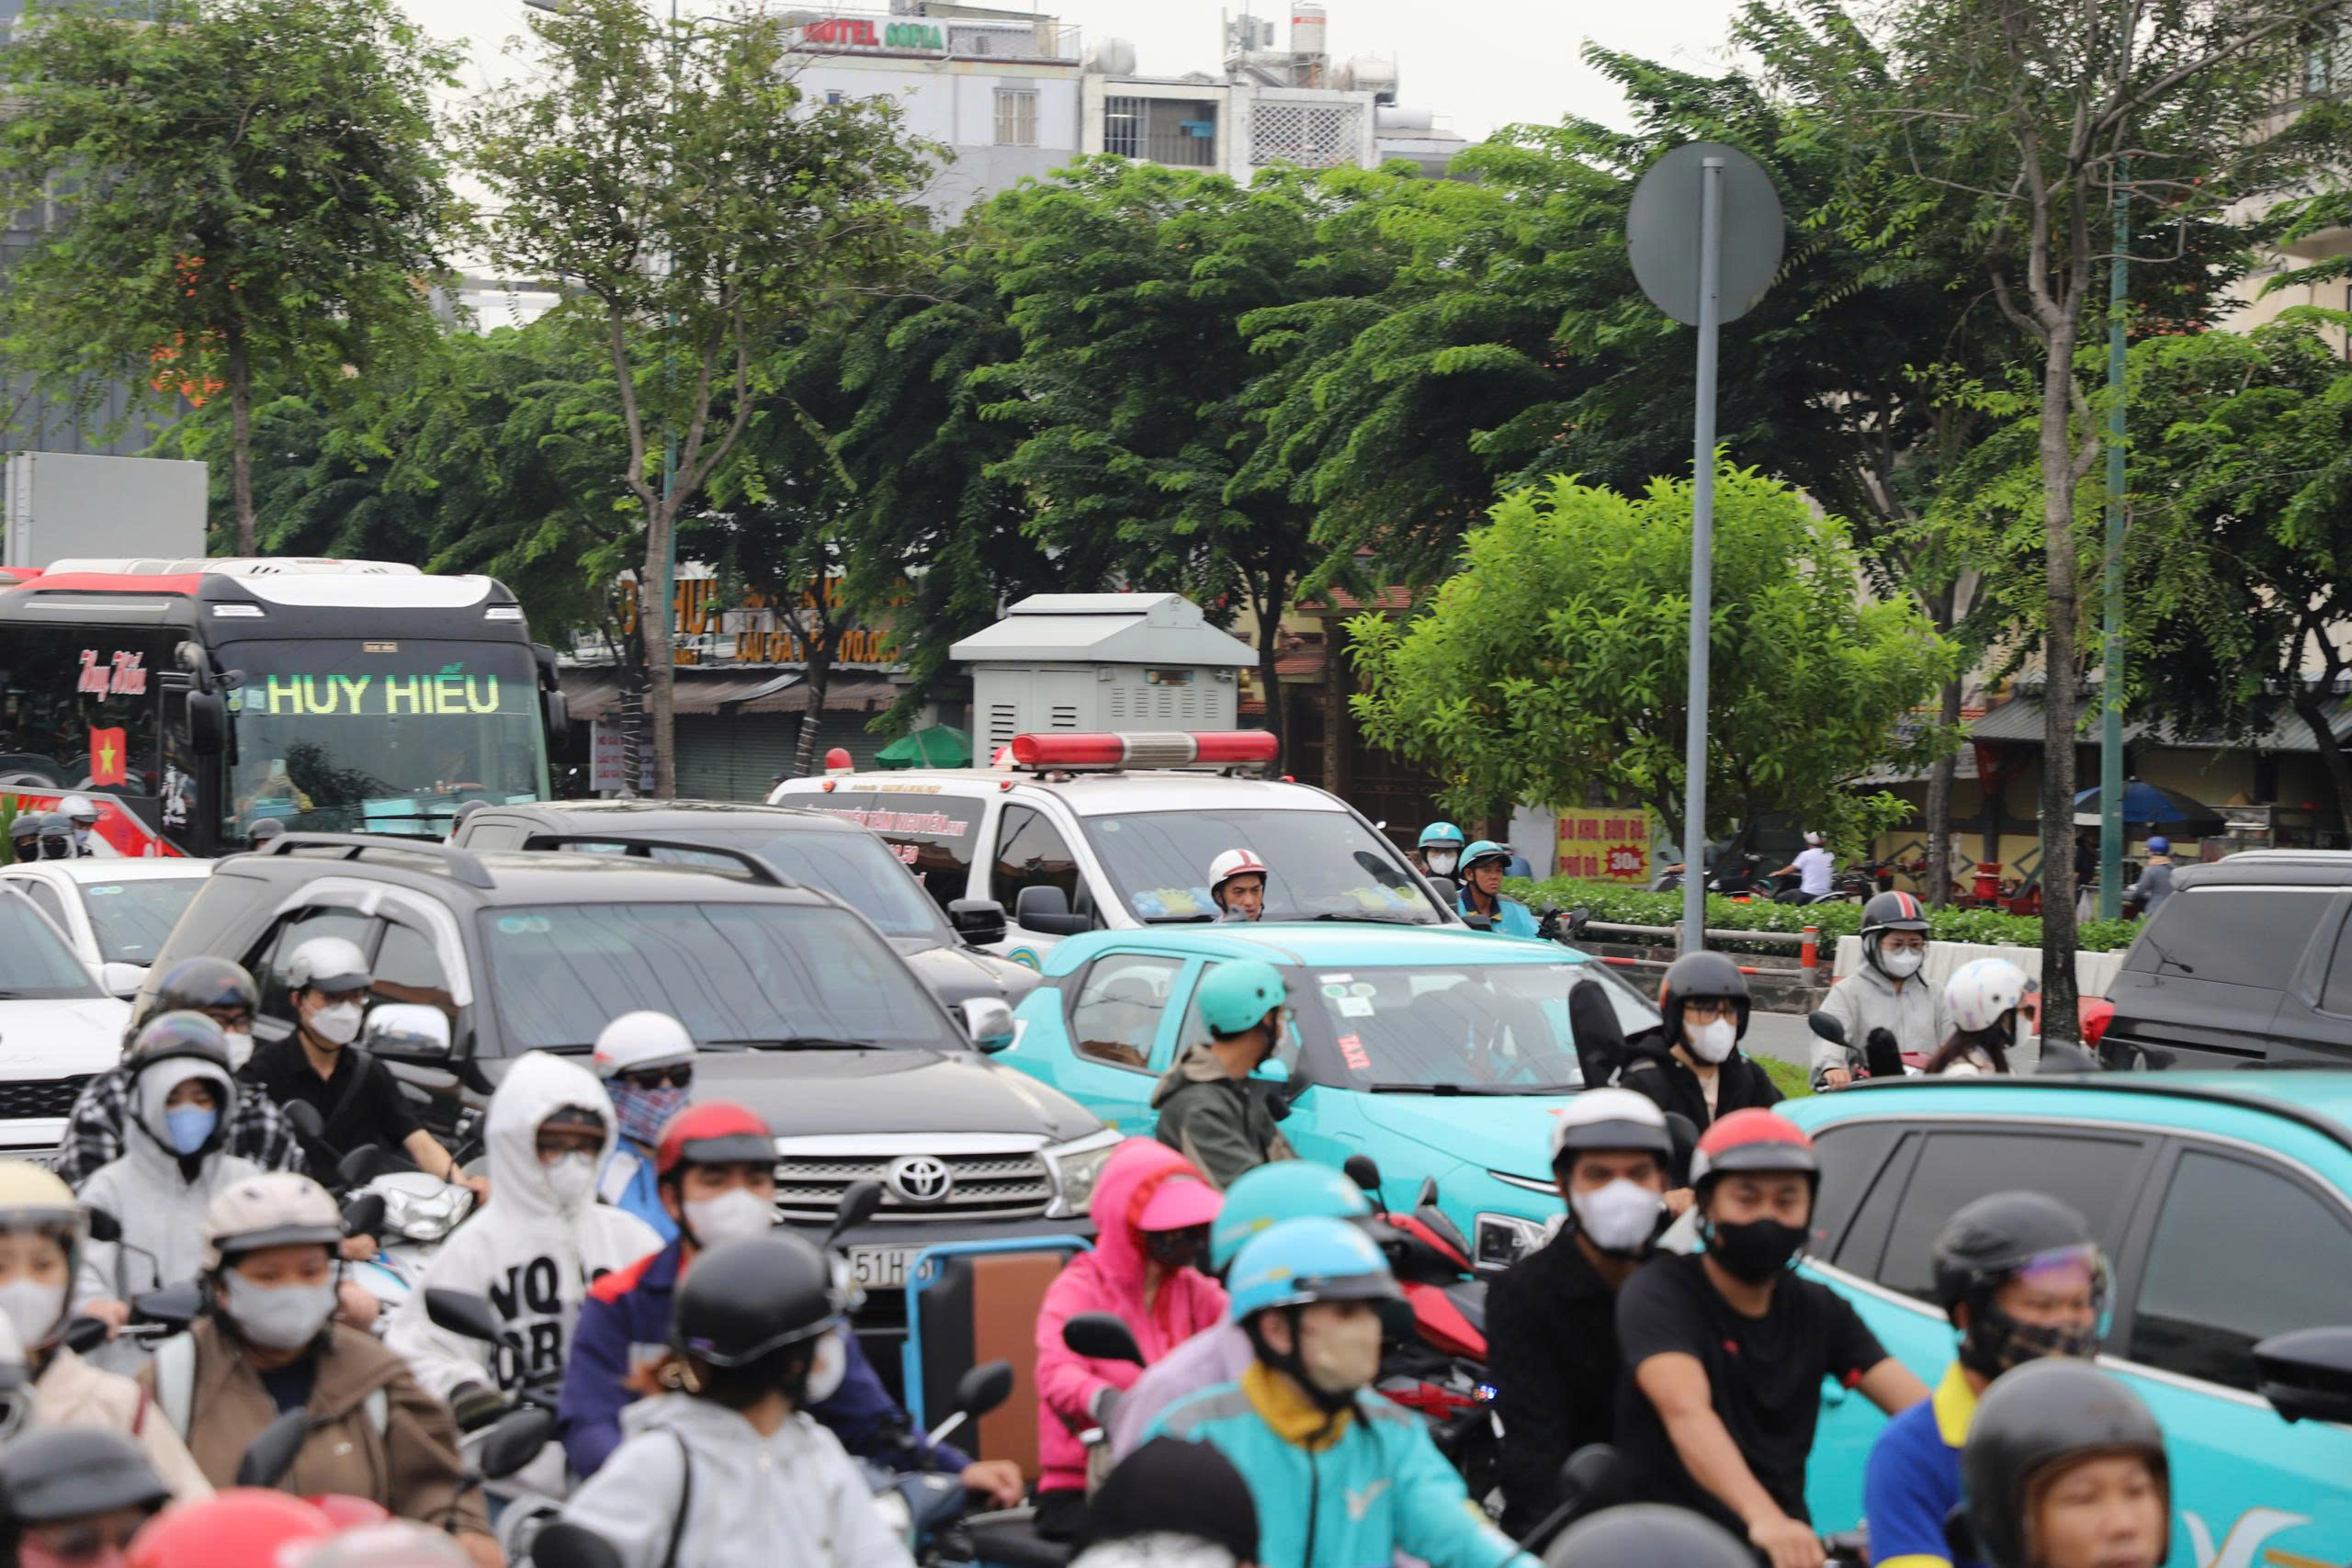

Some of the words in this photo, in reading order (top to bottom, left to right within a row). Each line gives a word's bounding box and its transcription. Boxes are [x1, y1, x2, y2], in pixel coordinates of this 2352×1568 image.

[803, 18, 880, 46] HOTEL
[266, 674, 372, 714] HUY
[385, 661, 499, 714] HIẾU
[1338, 1032, 1373, 1070] TAXI
